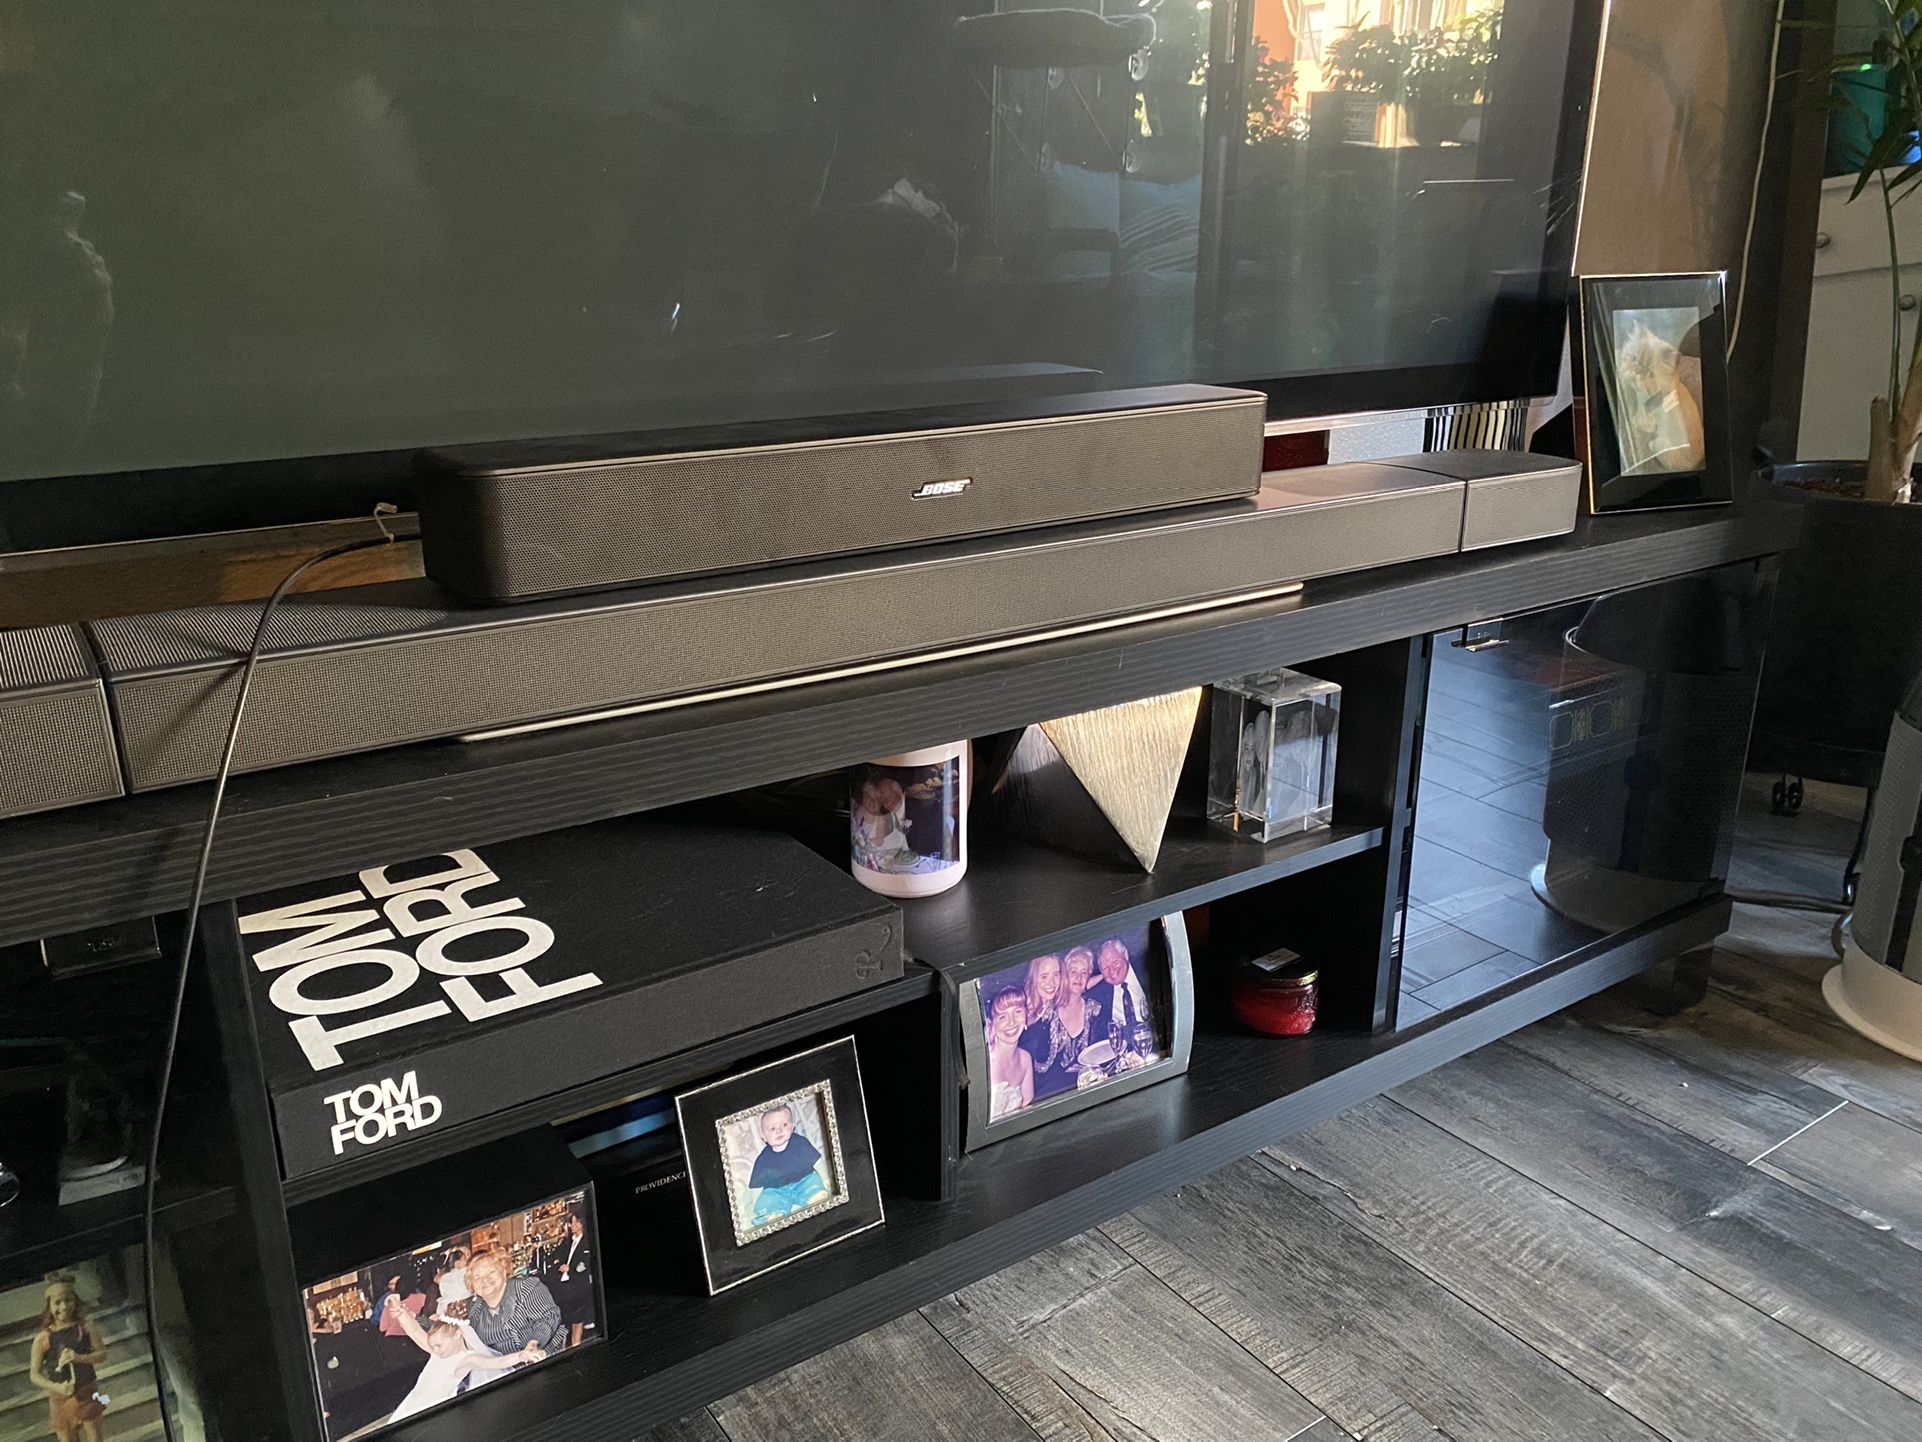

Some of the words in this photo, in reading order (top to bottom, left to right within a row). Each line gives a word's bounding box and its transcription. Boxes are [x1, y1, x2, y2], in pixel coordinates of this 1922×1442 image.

[912, 478, 971, 497] BOSE
[238, 890, 452, 1071] TOM
[323, 1070, 419, 1124] TOM
[330, 1095, 442, 1155] FORD
